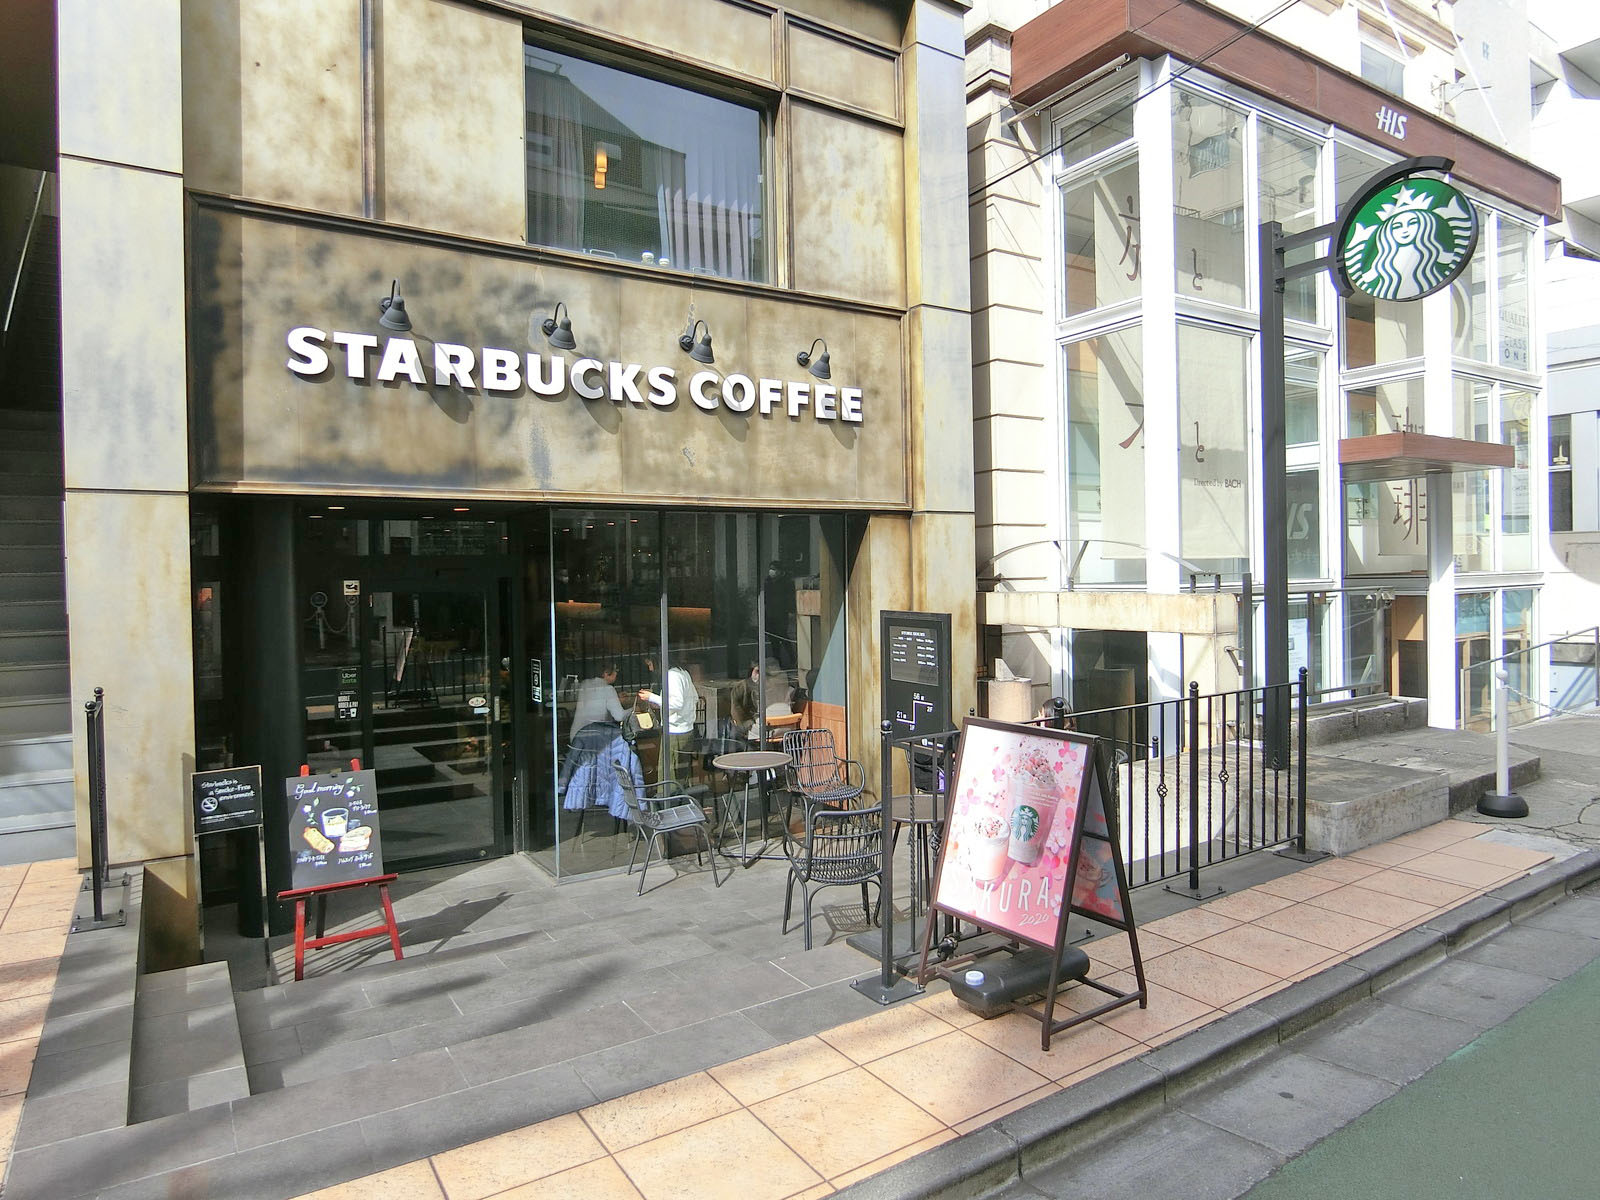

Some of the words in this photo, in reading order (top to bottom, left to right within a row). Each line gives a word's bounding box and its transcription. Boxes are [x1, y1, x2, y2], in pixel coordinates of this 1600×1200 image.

[1375, 105, 1408, 141] HIS
[287, 327, 677, 406] STARBUCKS
[690, 371, 863, 422] COFFEE
[1224, 478, 1242, 489] BACH
[201, 779, 232, 789] Starbucks
[295, 782, 318, 800] Good
[317, 783, 345, 795] morning
[981, 876, 1050, 913] KURA
[1018, 912, 1050, 927] 2020
